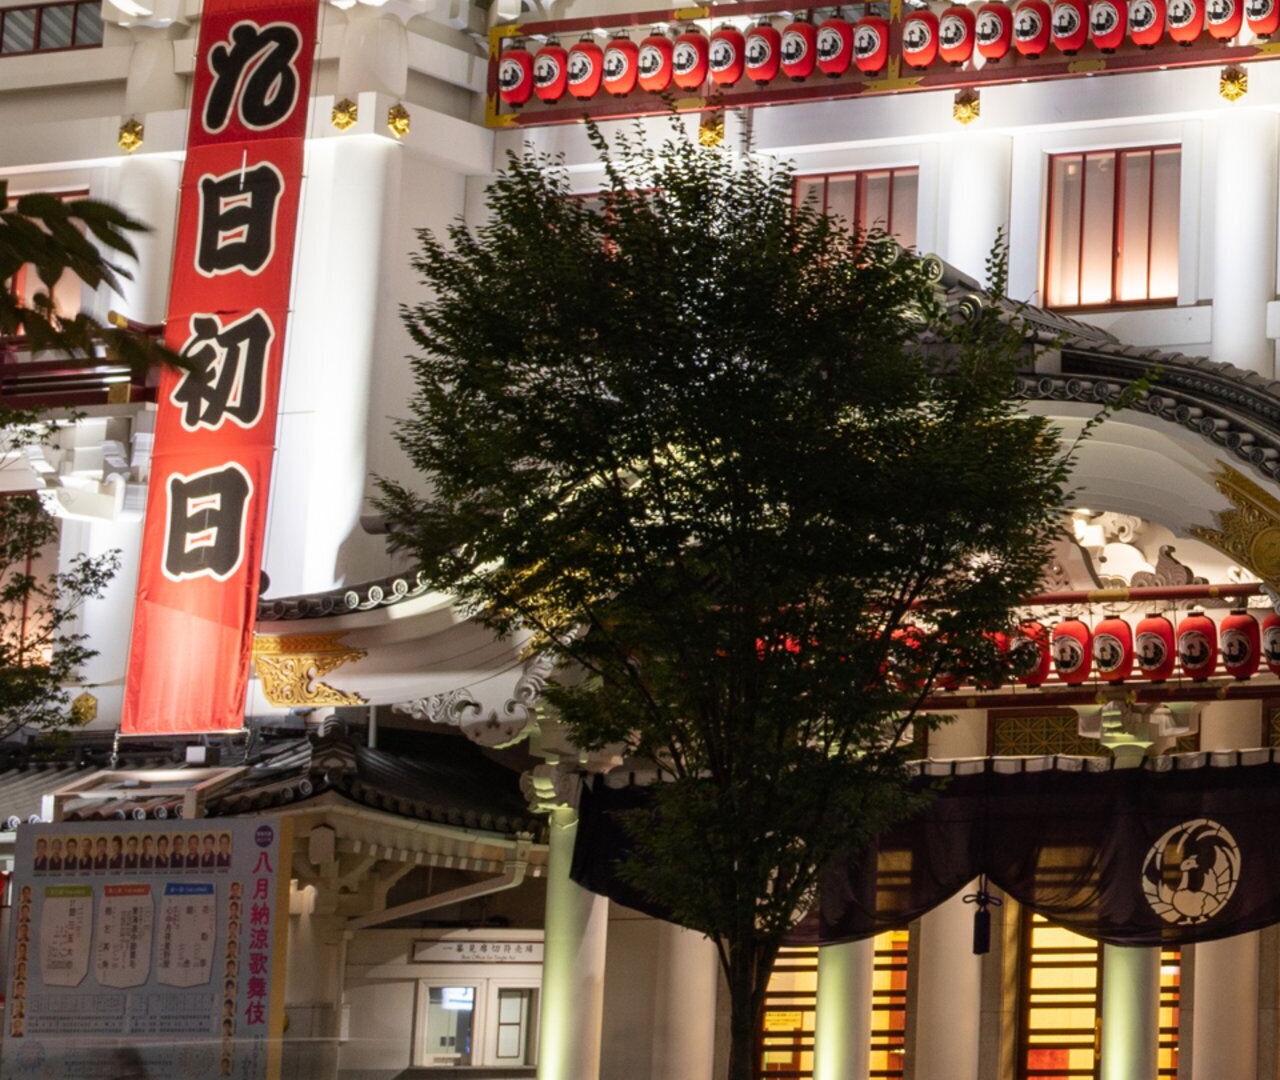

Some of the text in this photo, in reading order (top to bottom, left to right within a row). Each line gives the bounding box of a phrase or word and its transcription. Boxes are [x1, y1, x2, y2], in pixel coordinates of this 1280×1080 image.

[244, 850, 273, 1026] 八月納涼歌舞伎
